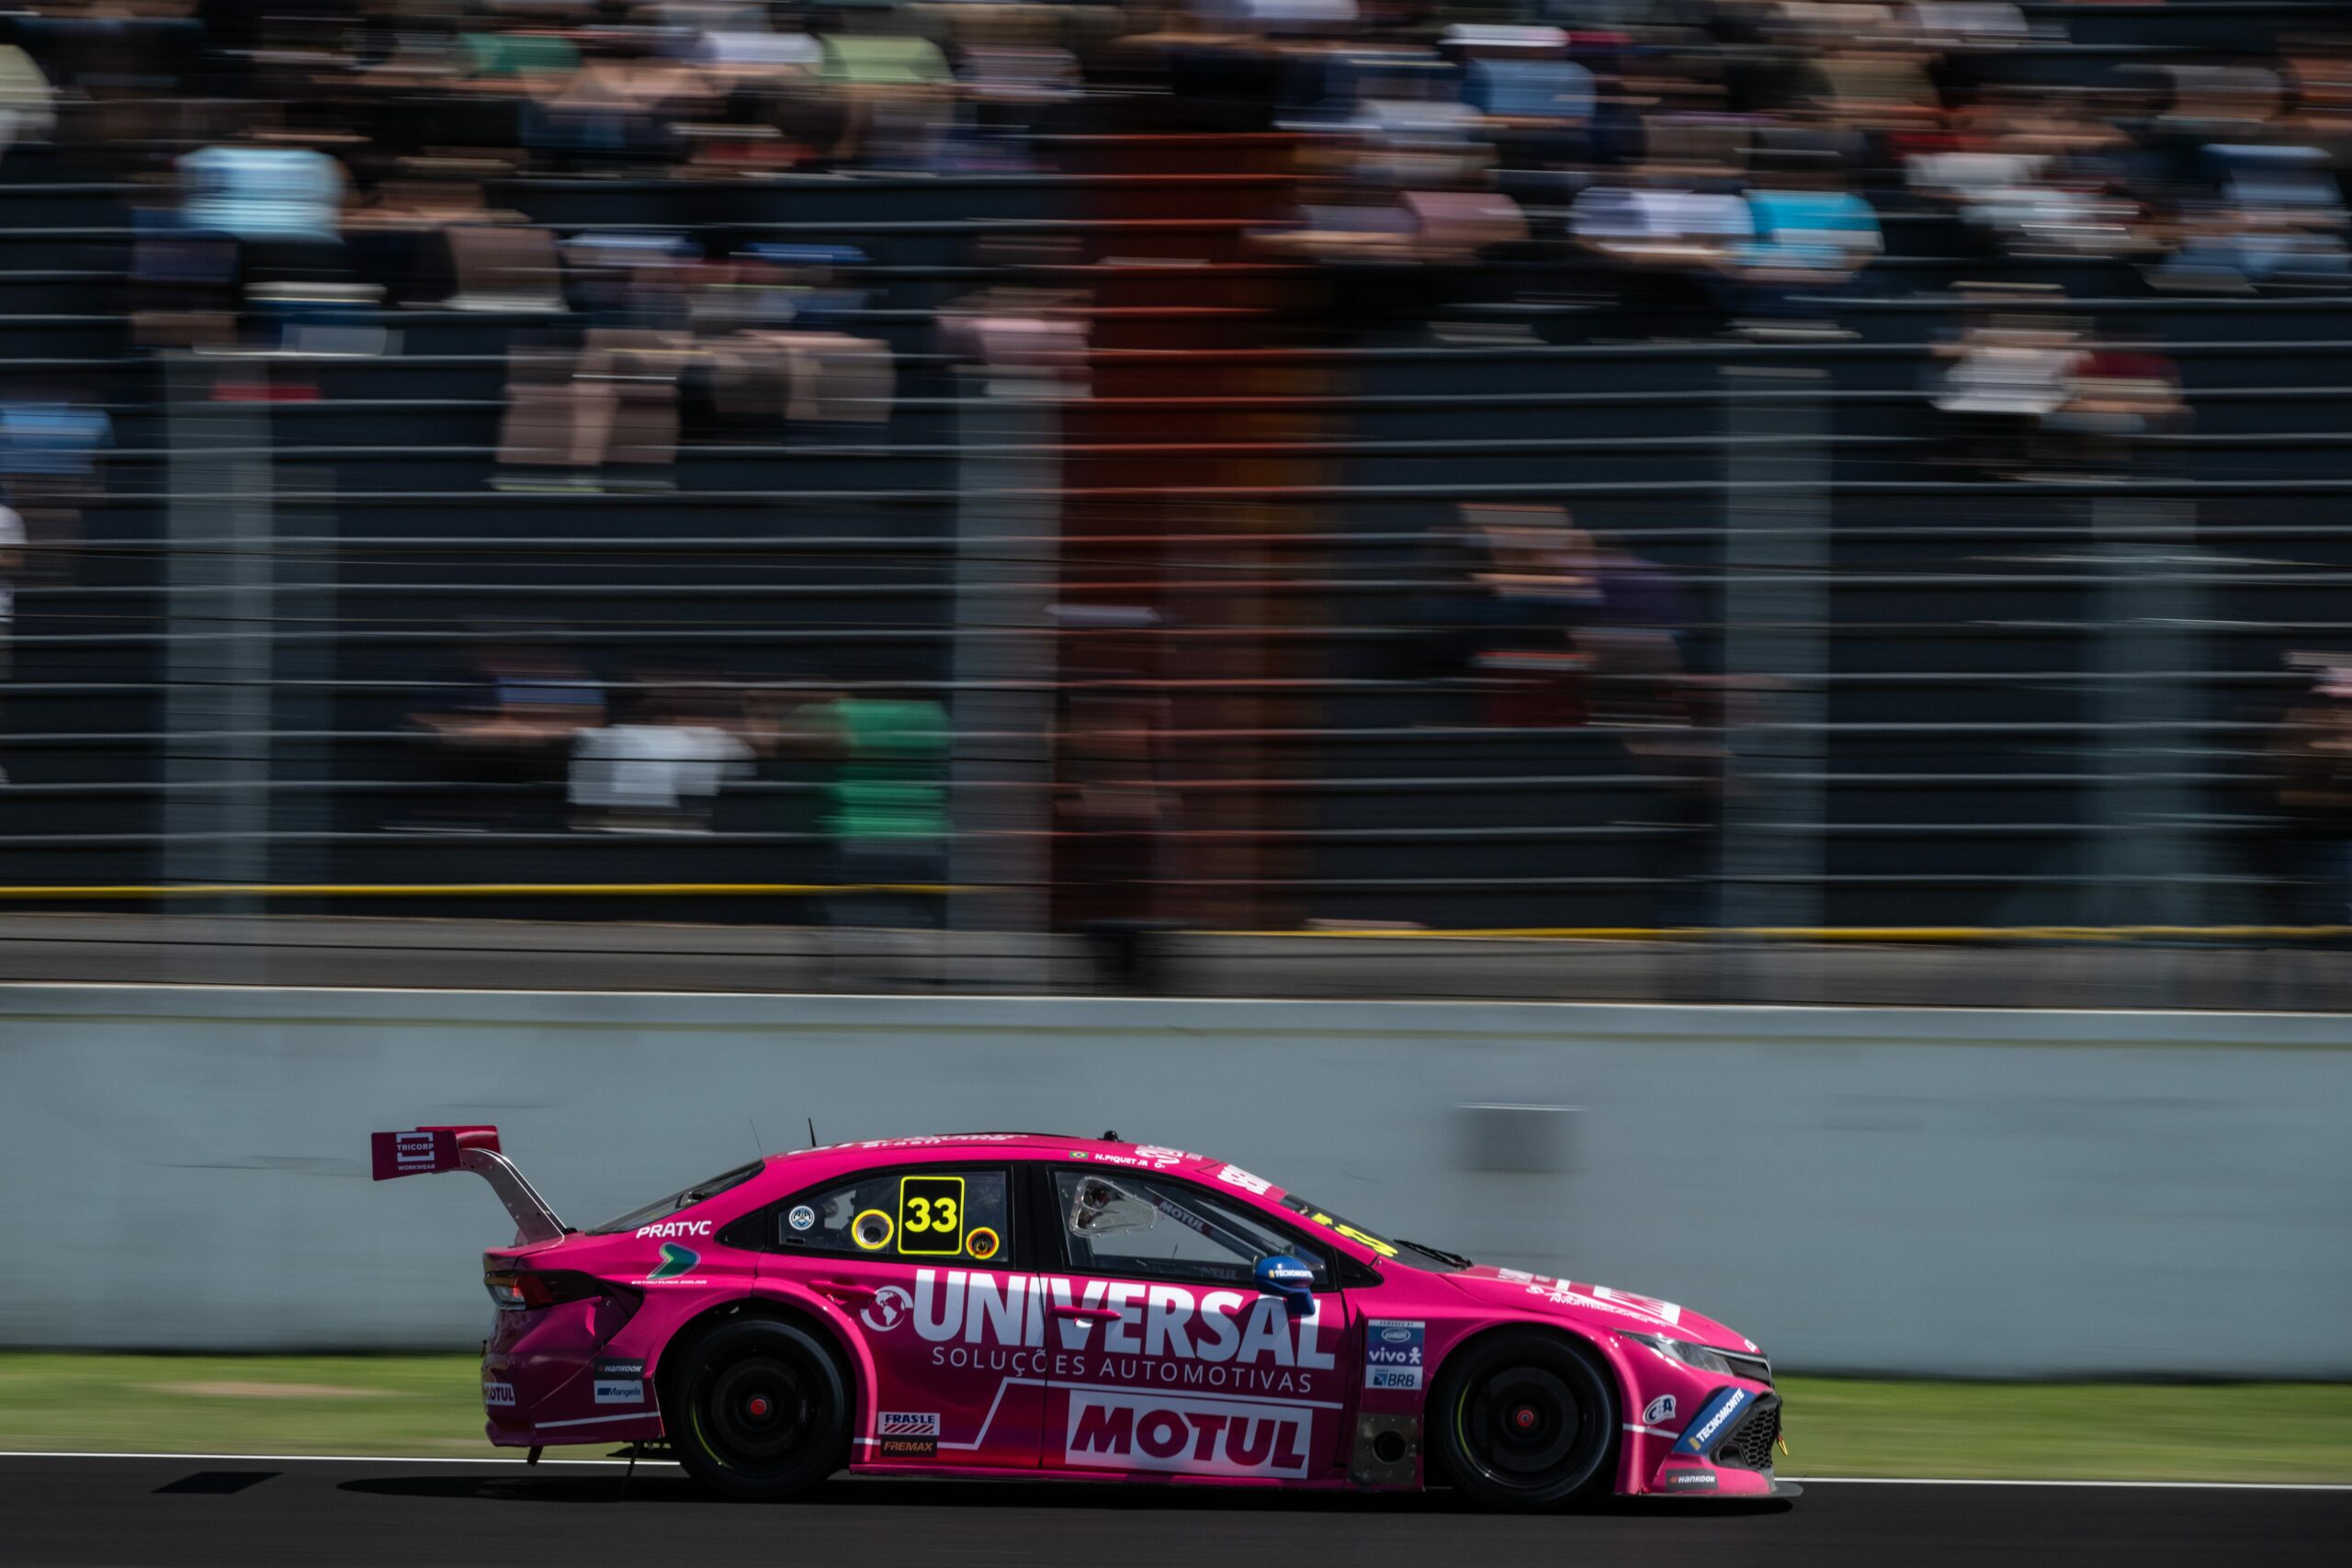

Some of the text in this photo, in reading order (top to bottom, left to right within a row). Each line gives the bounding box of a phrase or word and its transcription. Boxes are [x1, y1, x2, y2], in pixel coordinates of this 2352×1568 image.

[1095, 1154, 1136, 1165] N.PIQUET
[905, 1197, 957, 1233] 33
[1159, 1200, 1204, 1232] MOTUL
[636, 1221, 712, 1239] PRATYC
[912, 1268, 1335, 1371] UNIVERSAL
[1369, 1347, 1406, 1362] vivo
[932, 1346, 1312, 1393] SOLUÇÕES AUTOMOTIVAS
[1388, 1374, 1415, 1387] BRB
[609, 1387, 641, 1398] Mangels
[1649, 1397, 1672, 1420] CA
[1696, 1388, 1745, 1442] TECNOMONTE
[885, 1414, 935, 1424] FRASLE
[884, 1441, 933, 1451] FREMAX
[1070, 1404, 1306, 1470] MOTUL
